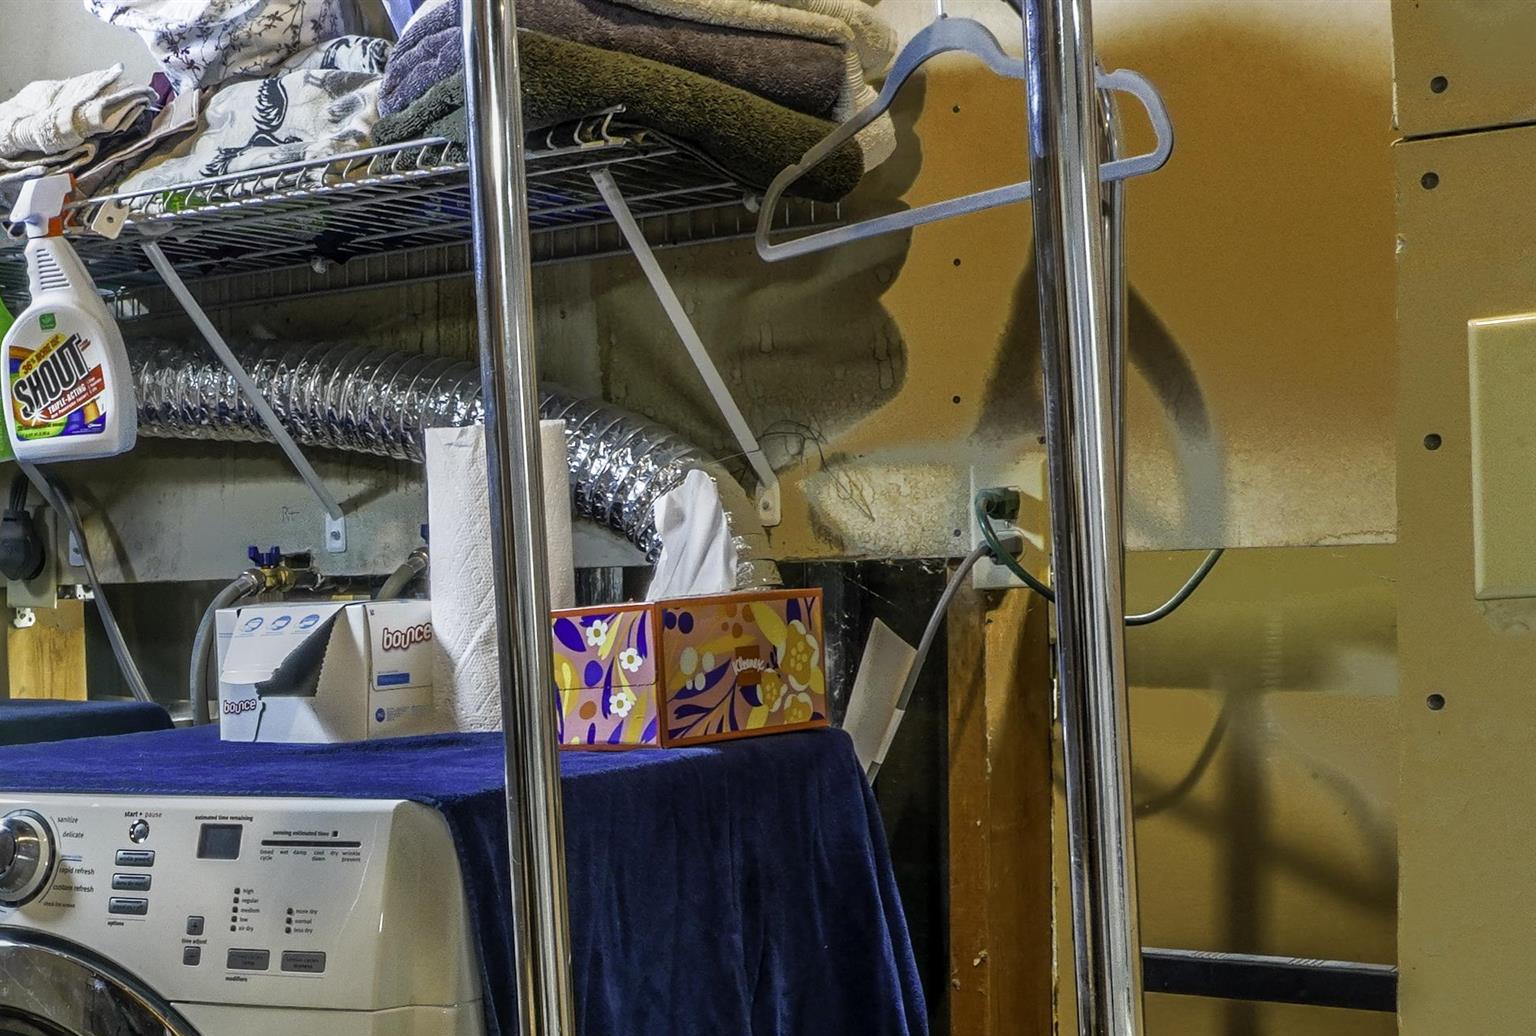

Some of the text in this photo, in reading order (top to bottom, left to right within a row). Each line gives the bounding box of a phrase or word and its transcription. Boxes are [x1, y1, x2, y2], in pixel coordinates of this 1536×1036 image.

[13, 333, 90, 420] SHOUT
[382, 622, 432, 651] bounce
[223, 699, 257, 715] bounce
[57, 816, 79, 824] sanitize
[62, 830, 84, 838] delicate
[74, 867, 95, 875] refresh
[74, 885, 95, 893] refresh
